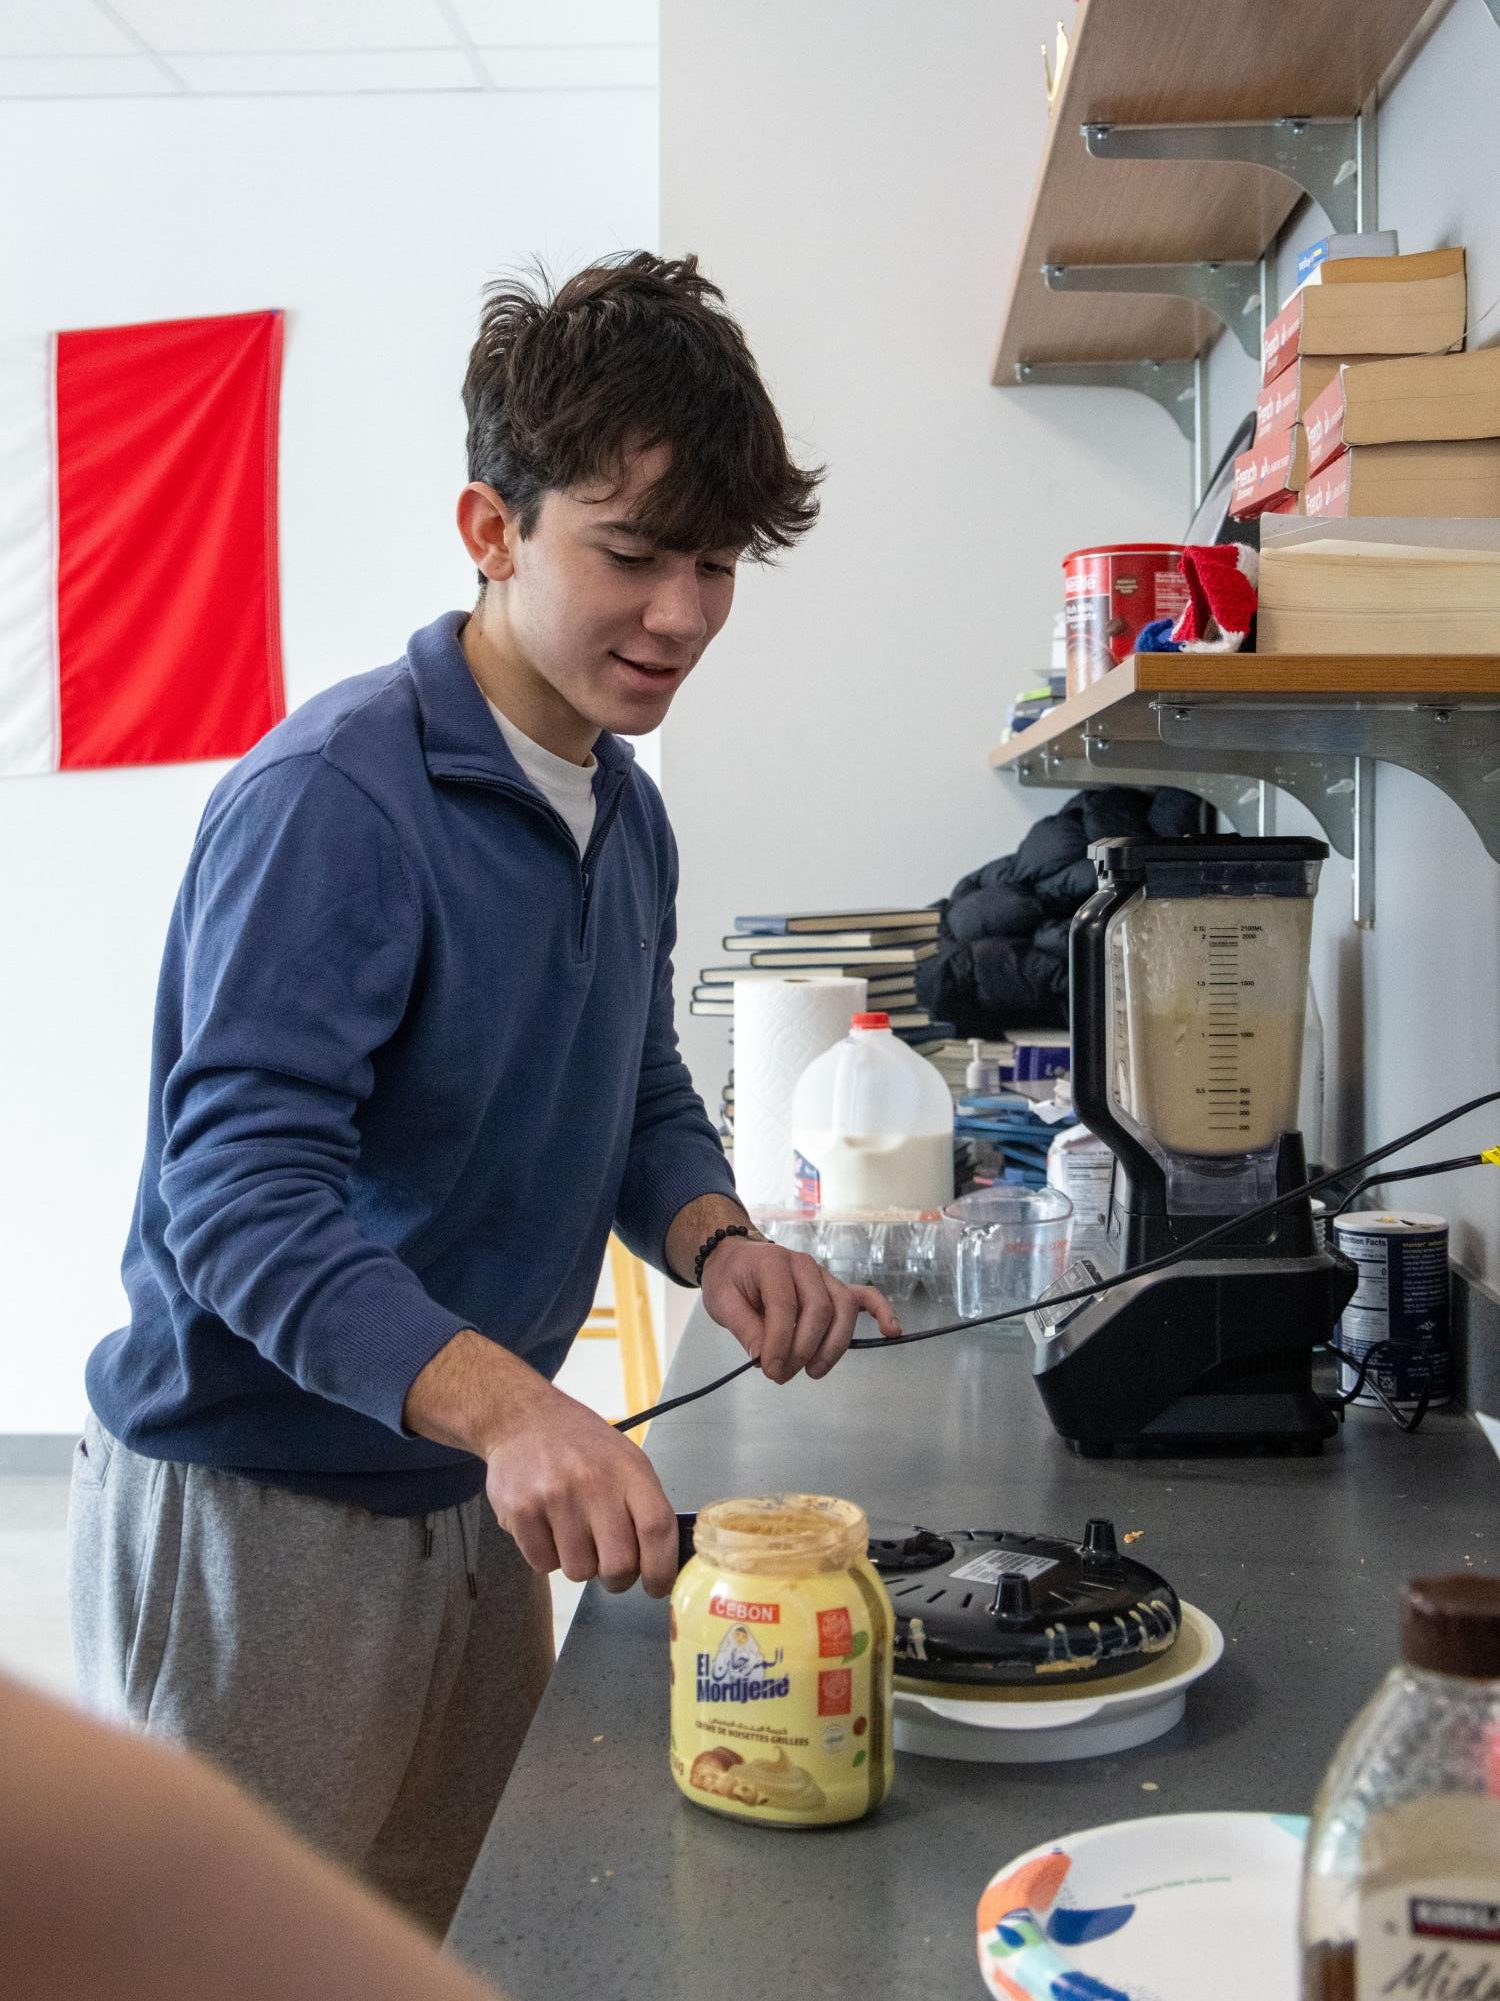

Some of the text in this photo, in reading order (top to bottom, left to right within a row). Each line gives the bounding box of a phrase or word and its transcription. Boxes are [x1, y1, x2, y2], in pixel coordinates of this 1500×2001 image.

[1235, 461, 1257, 490] French
[1366, 1237, 1387, 1247] Facts
[715, 1600, 774, 1621] CEBON
[696, 1653, 710, 1677] El
[717, 1726, 727, 1737] DE
[728, 1728, 769, 1743] NOISETTES
